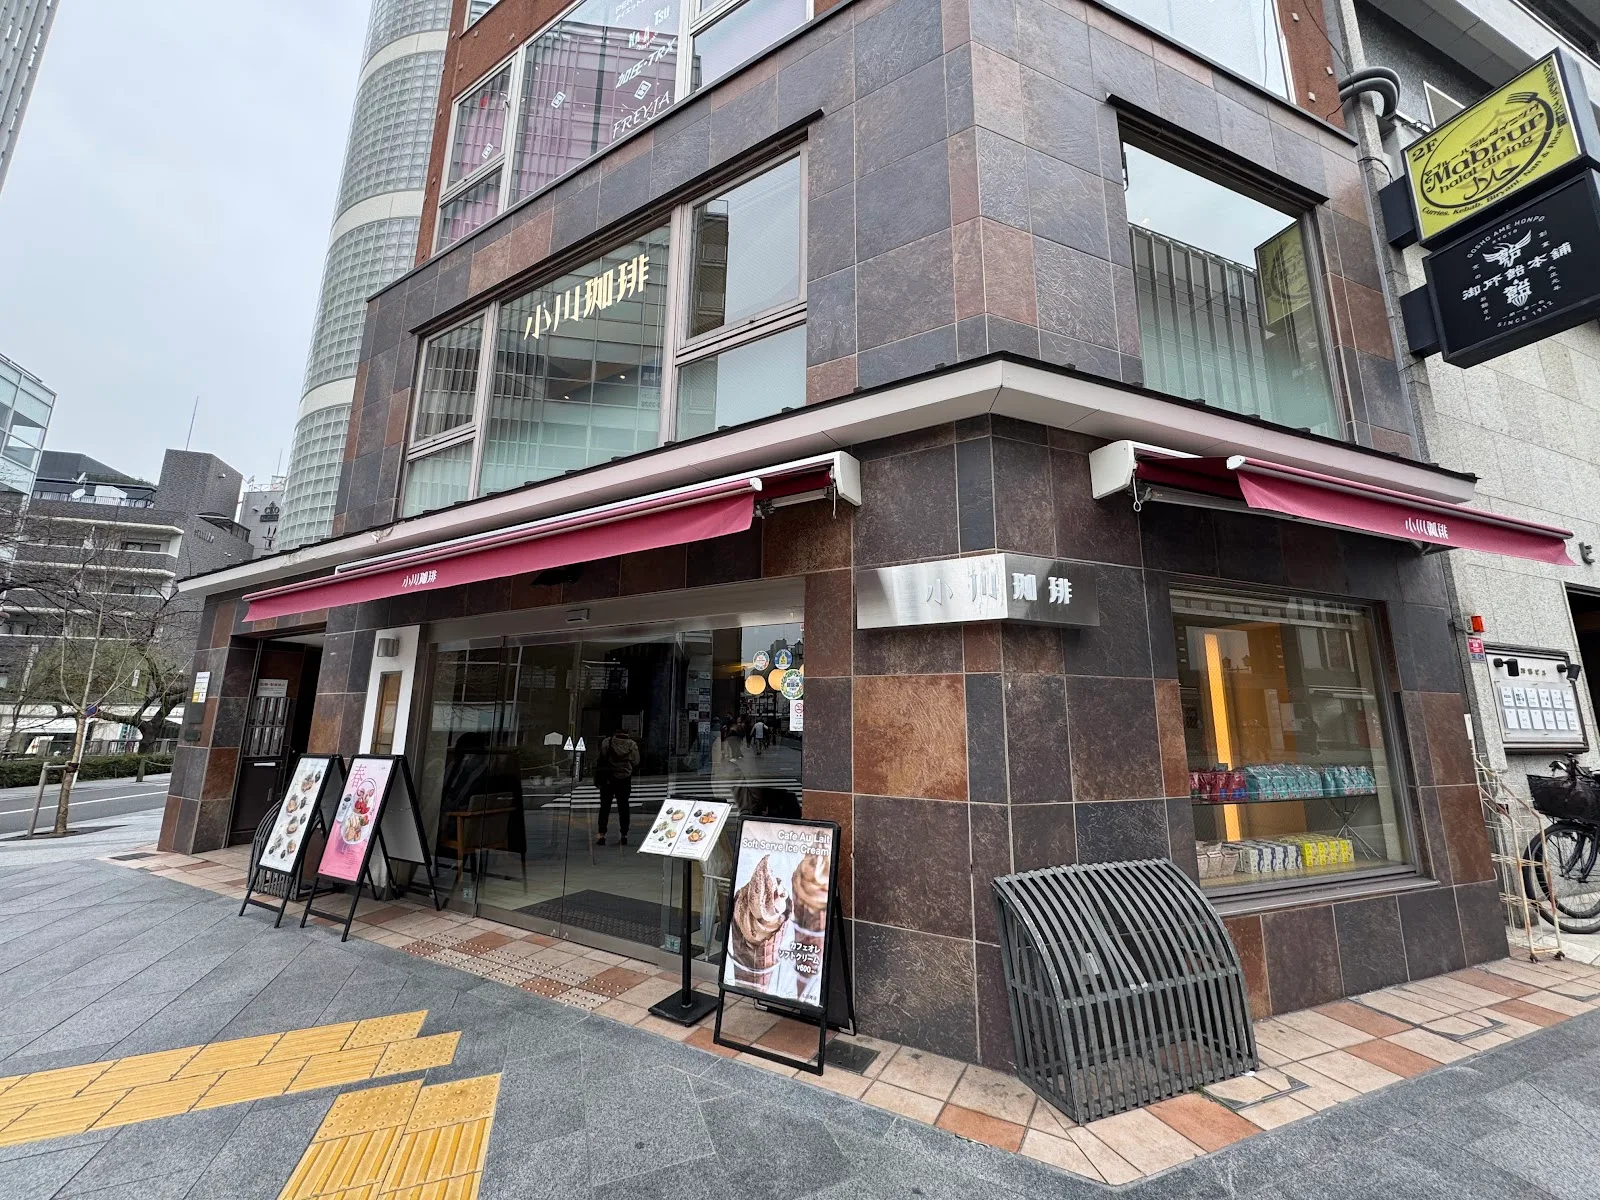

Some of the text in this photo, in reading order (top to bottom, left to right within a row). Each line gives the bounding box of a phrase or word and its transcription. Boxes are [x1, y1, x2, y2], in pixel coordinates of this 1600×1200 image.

[1412, 137, 1438, 163] 2F
[1424, 112, 1545, 193] Mabrur
[1523, 160, 1542, 177] Nan
[1546, 127, 1564, 149] Rice
[1440, 134, 1533, 194] halal dining
[1467, 215, 1545, 258] GOSHO AME HONPO
[1462, 241, 1572, 301] 御所飴本舗
[524, 253, 649, 341] 小川珈琲
[1497, 315, 1527, 328] SINCE
[1532, 301, 1553, 316] 1912
[1405, 517, 1449, 540] 小川珈琲
[402, 569, 437, 588] 小川珈琲
[926, 571, 1073, 607] 小川珈琲
[352, 763, 367, 788] 春
[742, 838, 830, 856] Soft Serve Ice Cream
[778, 830, 831, 844] Cafe Au Lait
[779, 950, 820, 965] ソフトクリーム
[790, 941, 821, 954] カフェオレ
